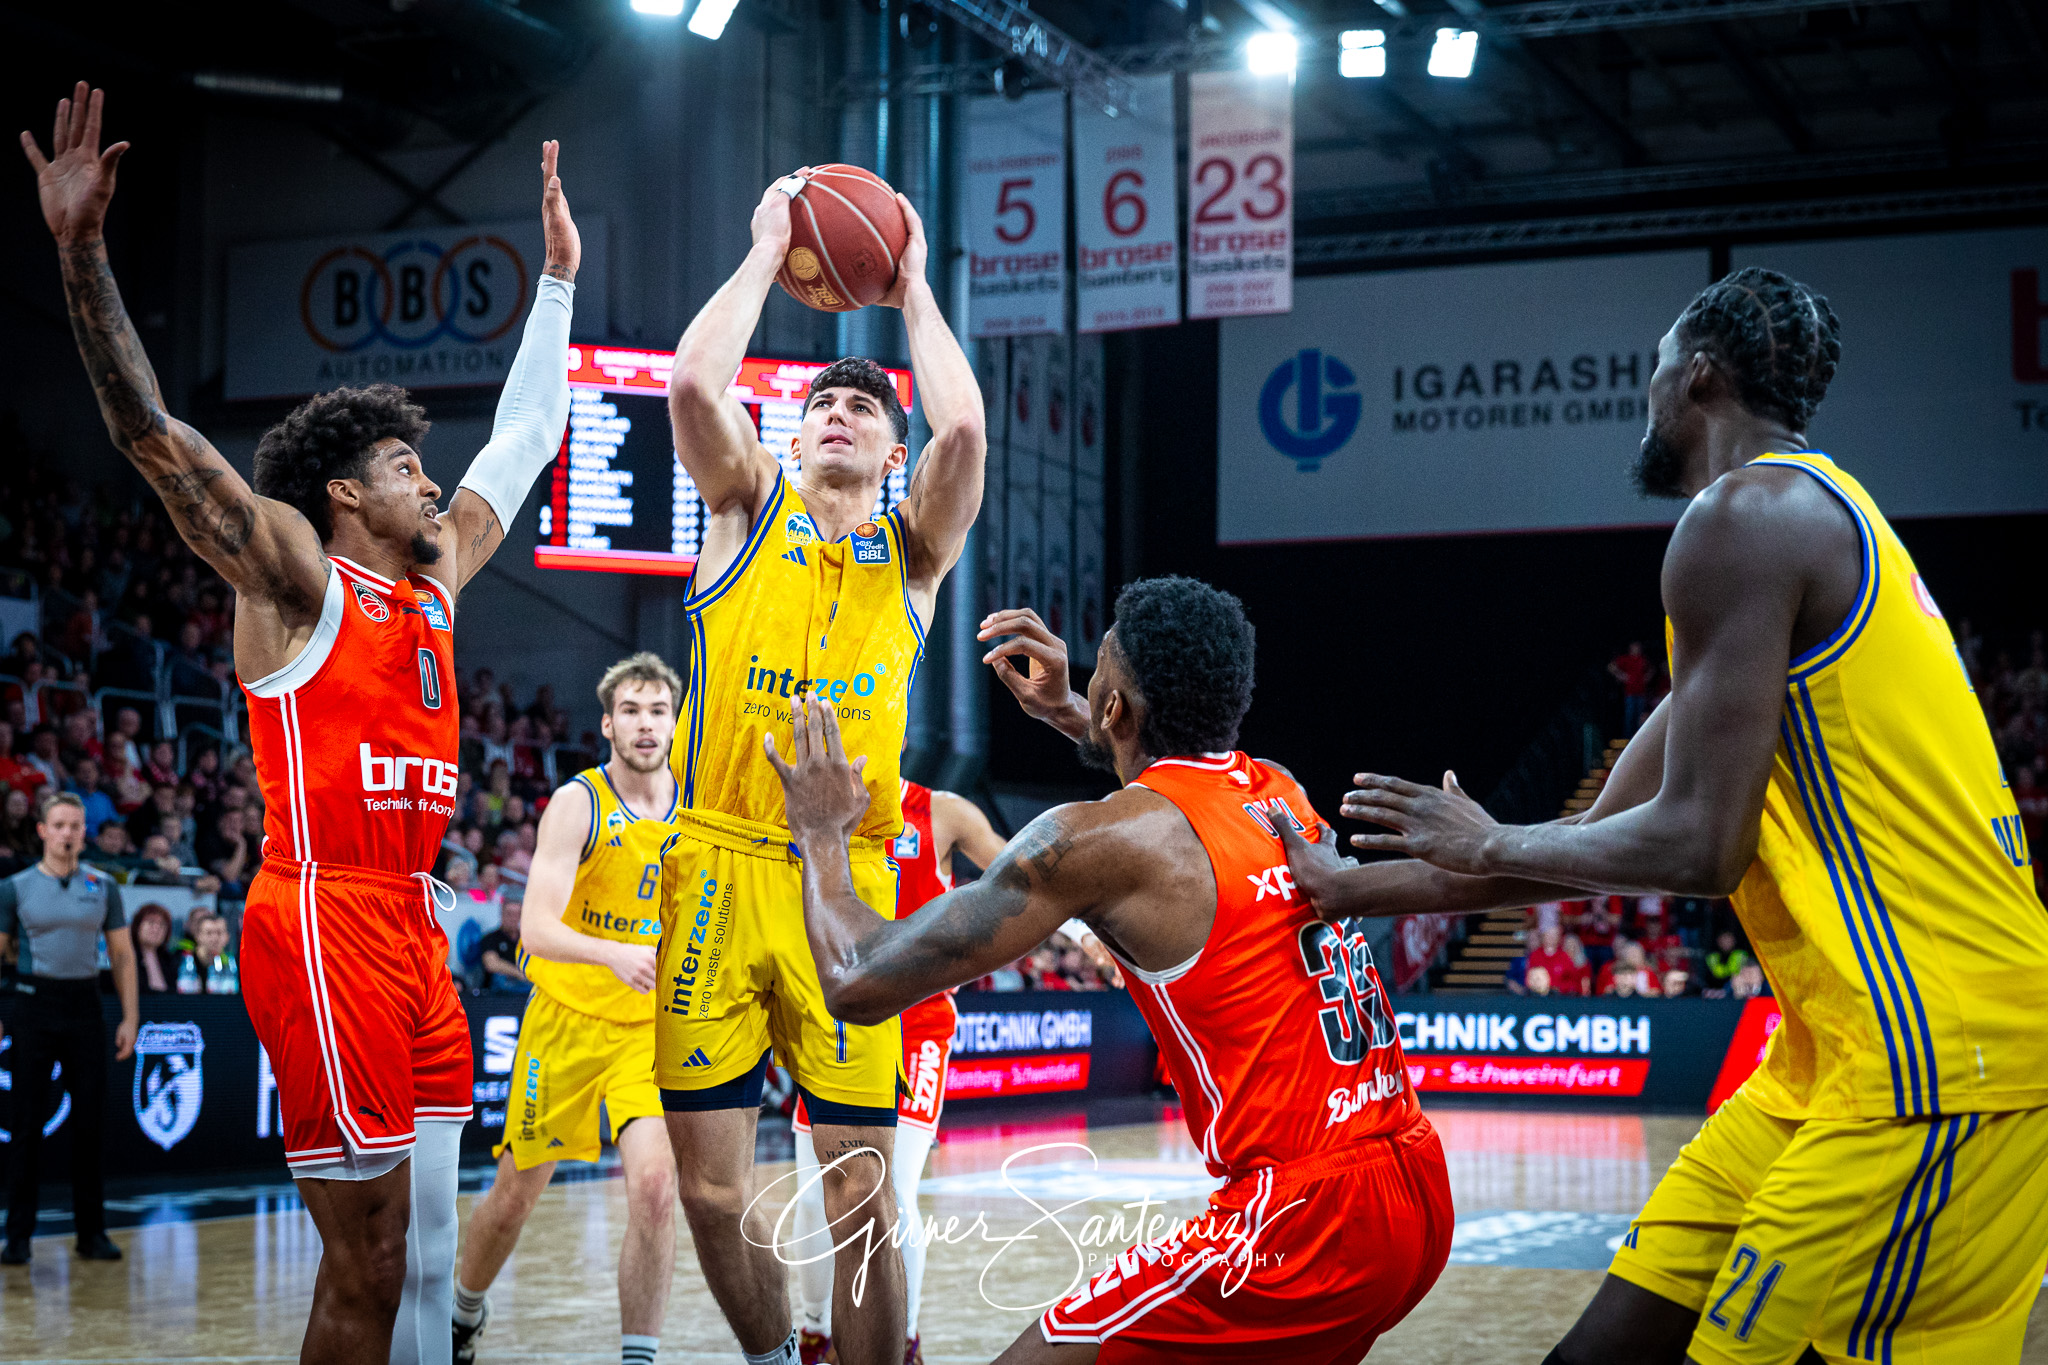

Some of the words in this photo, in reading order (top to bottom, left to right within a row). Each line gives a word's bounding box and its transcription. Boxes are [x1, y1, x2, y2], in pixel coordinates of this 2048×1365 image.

[1103, 169, 1147, 238] 6
[1195, 153, 1287, 225] 23
[995, 178, 1036, 244] 5
[1079, 242, 1173, 270] brose
[1192, 230, 1287, 254] brose
[970, 251, 1059, 277] brose
[334, 258, 492, 327] BBS
[316, 350, 501, 380] AUTOMATION
[1393, 403, 1551, 433] MOTOREN
[858, 549, 886, 561] BBL
[418, 648, 441, 710] 0
[744, 702, 771, 717] zero
[359, 742, 459, 800] bros
[363, 797, 413, 811] Technik
[637, 863, 660, 900] 6
[581, 900, 662, 935] interze
[712, 882, 734, 945] solutions
[706, 948, 722, 989] waste
[698, 991, 713, 1019] zero
[1040, 1009, 1093, 1049] GMBH
[1522, 1013, 1652, 1053] GMBH
[1450, 1060, 1621, 1088] Schweinfurt
[1706, 1243, 1787, 1343] 21
